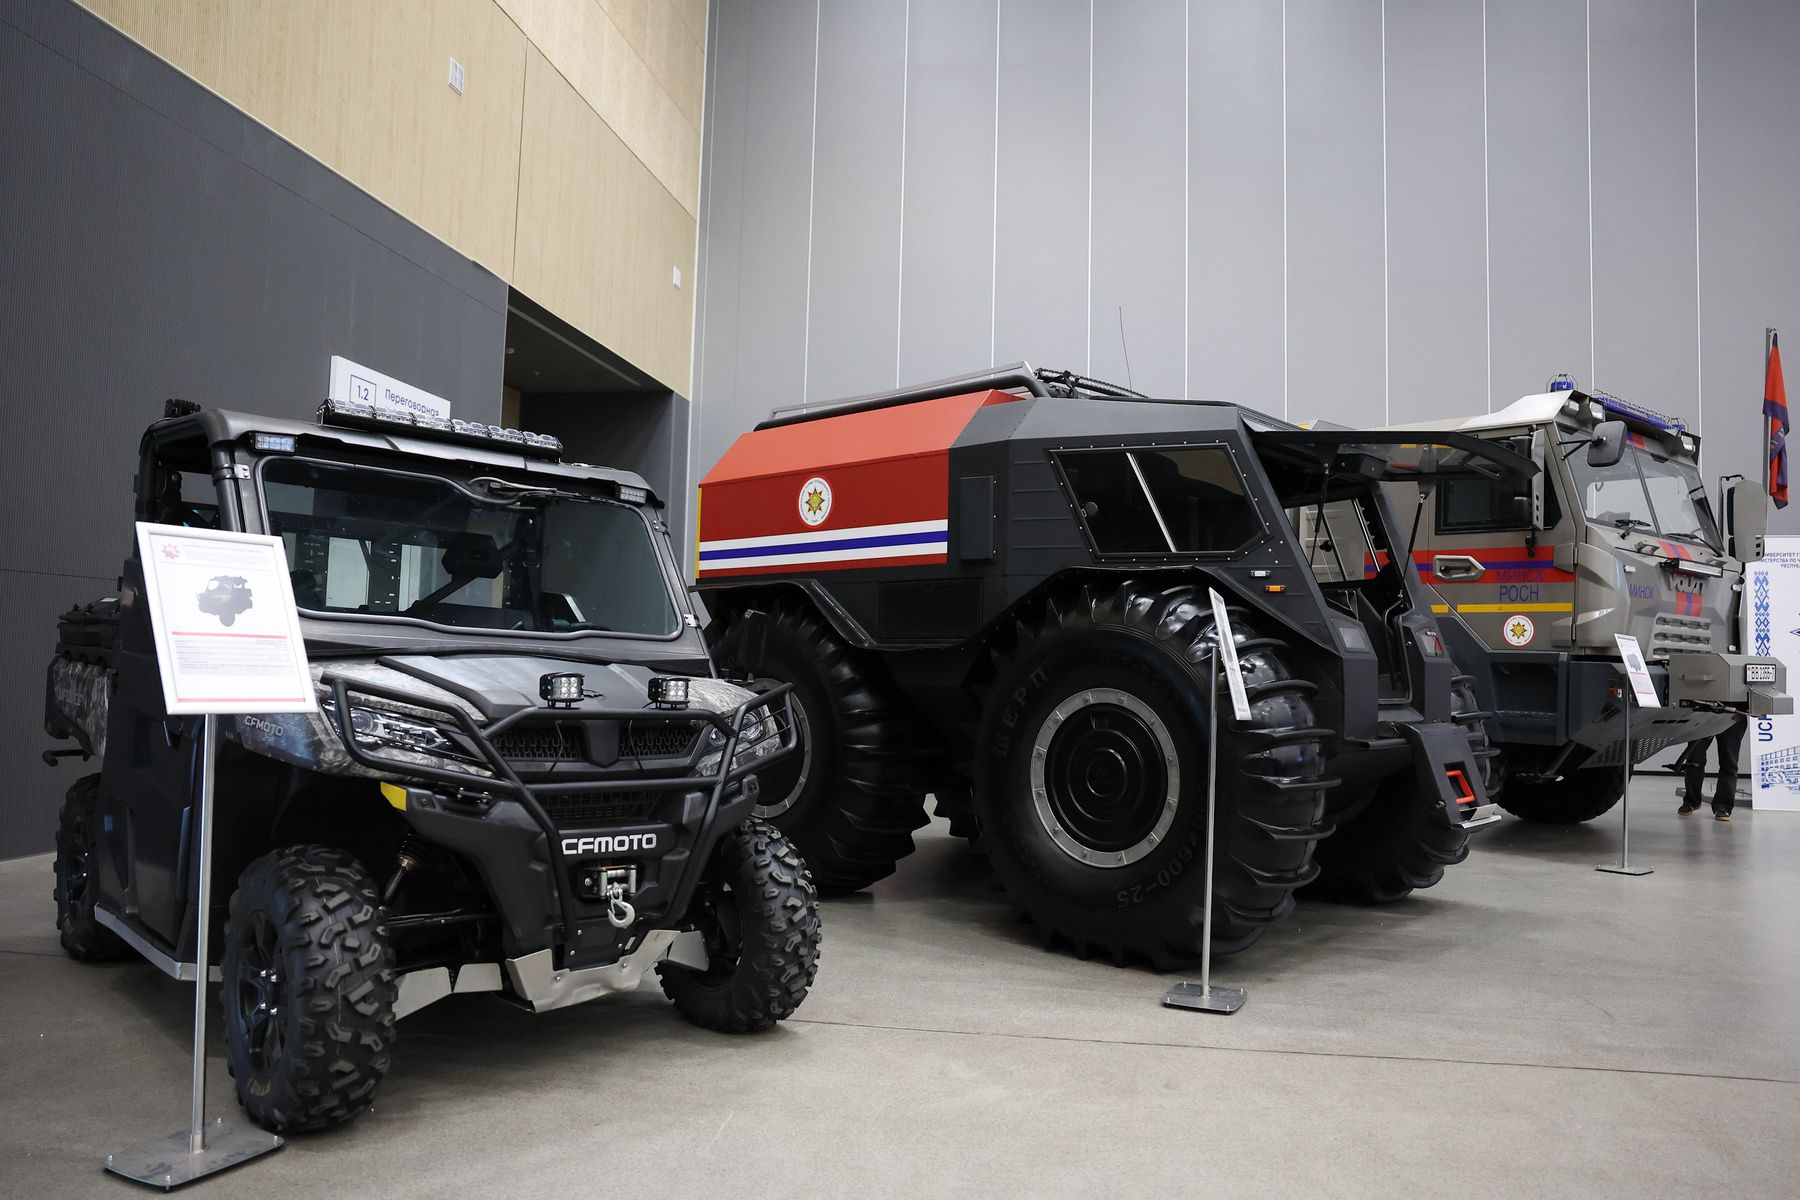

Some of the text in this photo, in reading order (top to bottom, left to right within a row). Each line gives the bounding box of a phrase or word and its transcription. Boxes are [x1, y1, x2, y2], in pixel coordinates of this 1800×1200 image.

[357, 385, 369, 400] 1.2
[385, 389, 439, 417] Переговорная
[1499, 584, 1540, 602] РОСН
[245, 715, 284, 737] CFMOTO
[561, 833, 657, 855] CFMOTO
